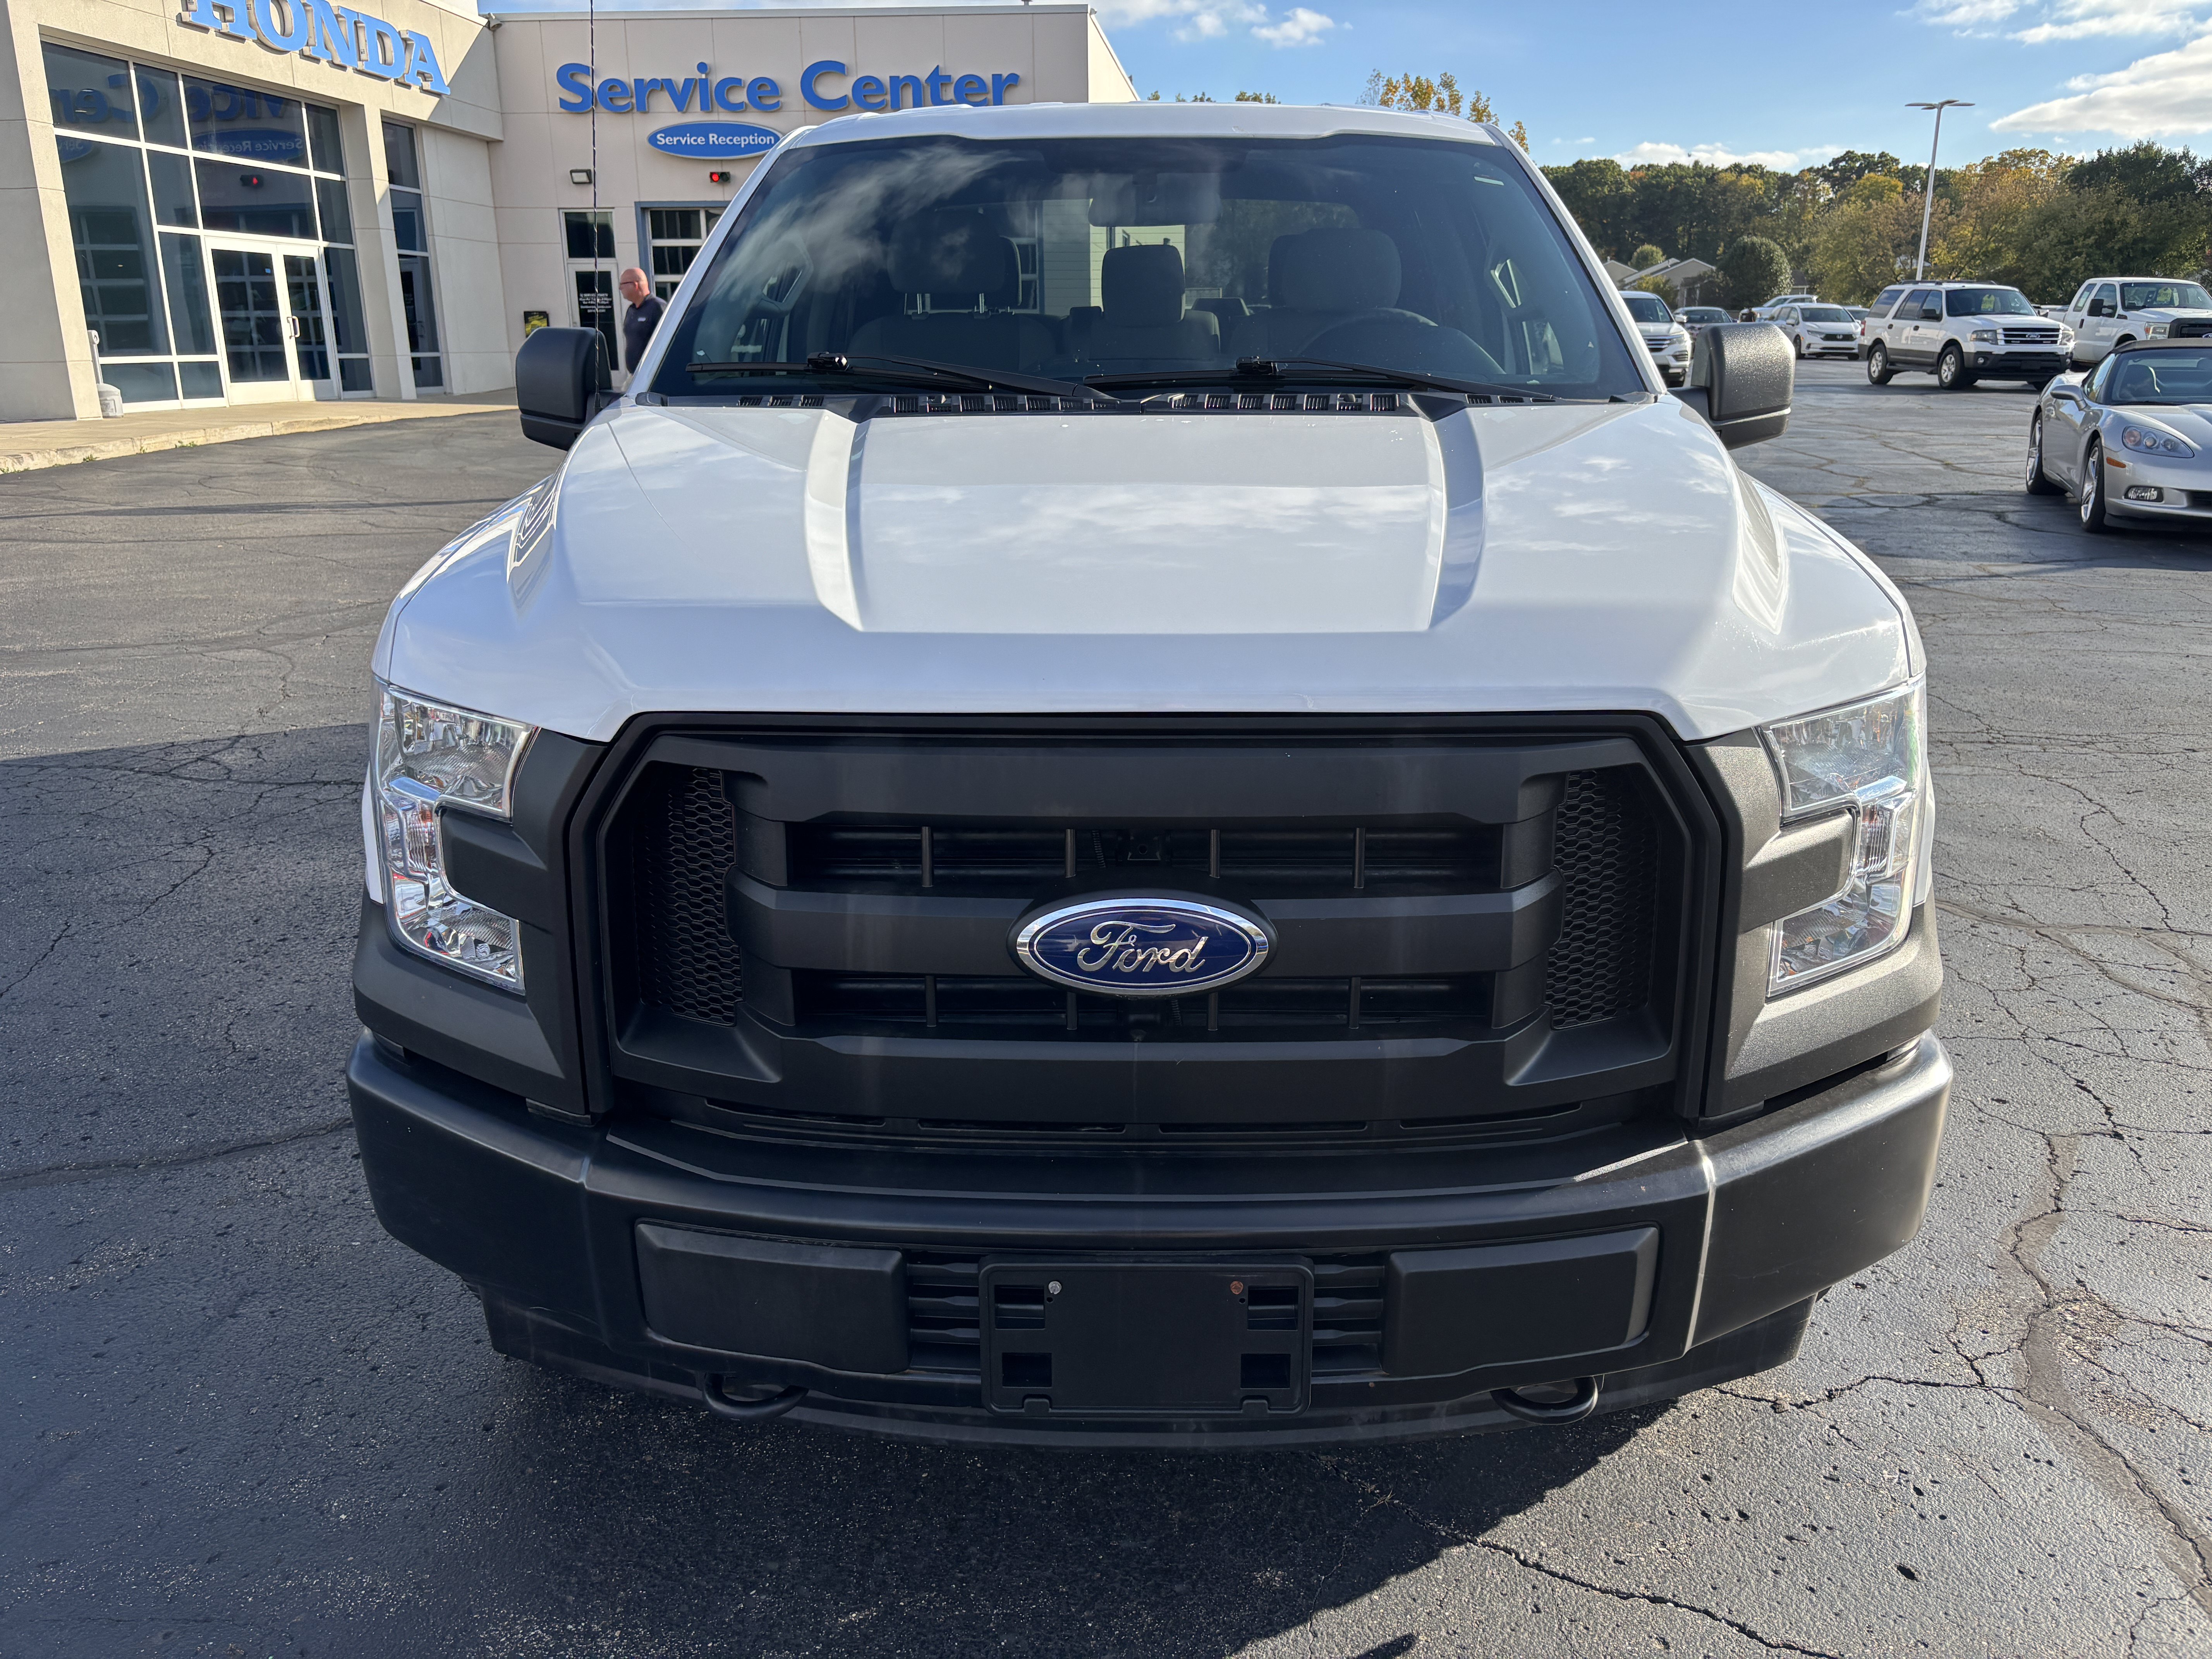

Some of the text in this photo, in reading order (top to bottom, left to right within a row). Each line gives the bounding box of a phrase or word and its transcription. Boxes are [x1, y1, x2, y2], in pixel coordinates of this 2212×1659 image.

[190, 0, 451, 95] HONDA
[556, 60, 1020, 113] Service Center
[657, 133, 775, 148] Service Reception
[1077, 921, 1209, 973] Ford
